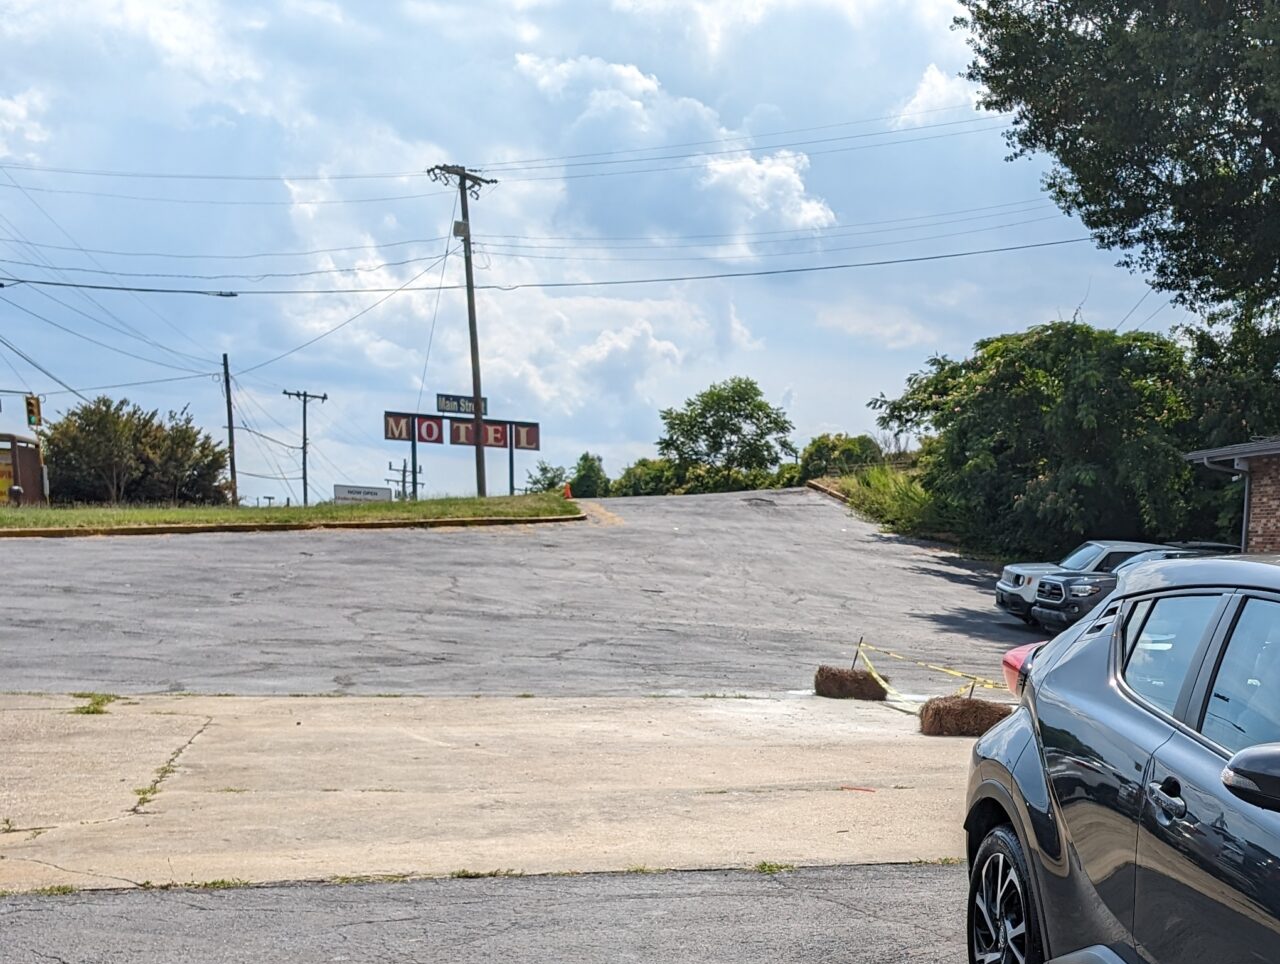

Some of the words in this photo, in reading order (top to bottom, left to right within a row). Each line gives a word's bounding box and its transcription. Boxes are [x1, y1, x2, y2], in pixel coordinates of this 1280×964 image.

[438, 396, 458, 412] Main
[459, 399, 485, 414] Strt
[386, 415, 536, 449] MOTEL
